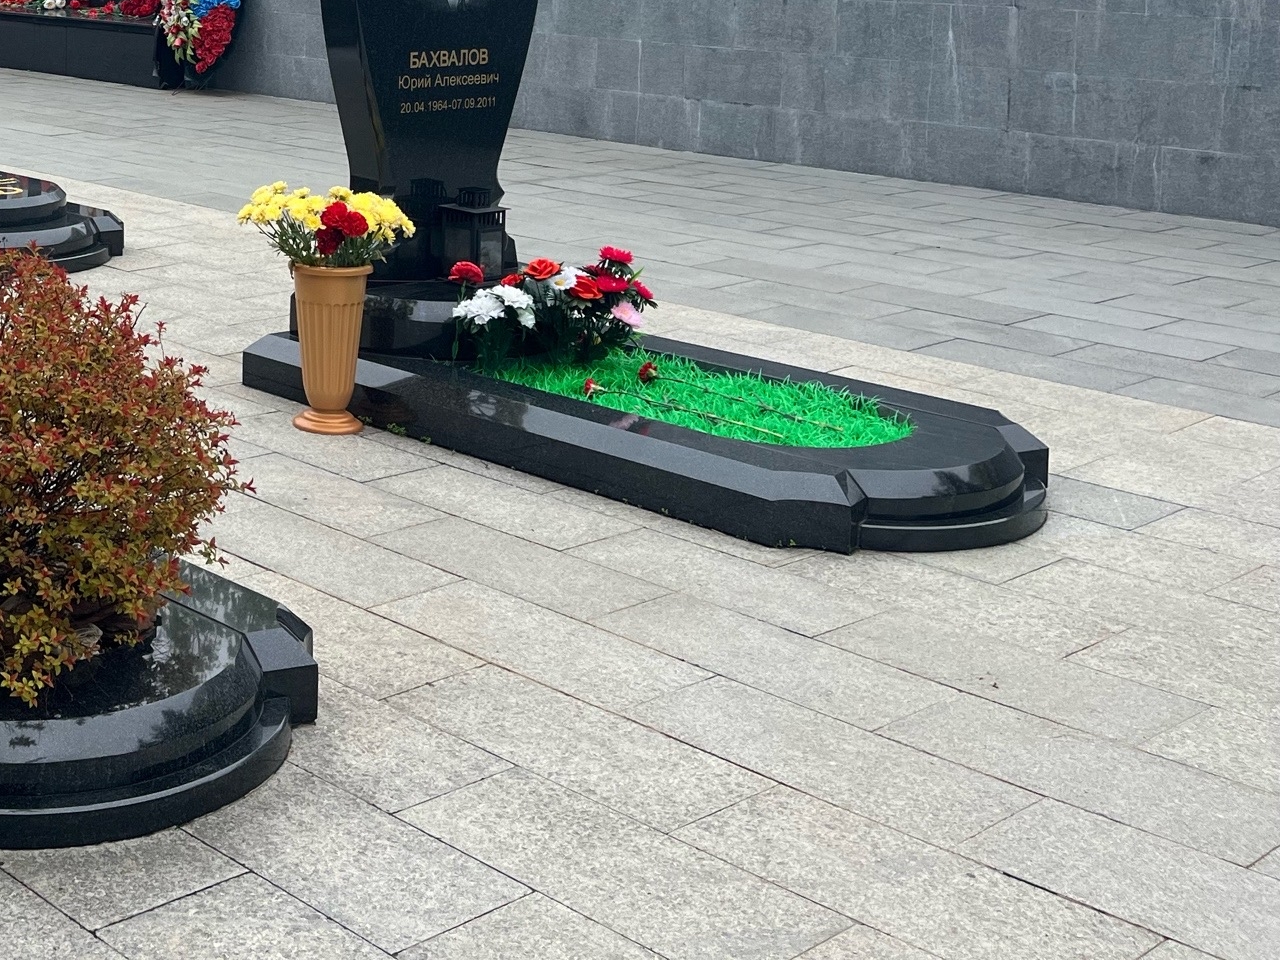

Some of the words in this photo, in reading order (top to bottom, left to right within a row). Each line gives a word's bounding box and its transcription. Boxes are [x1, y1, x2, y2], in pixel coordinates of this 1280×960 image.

[410, 48, 489, 69] БАХВАЛОВ
[398, 74, 432, 91] Юрий
[434, 72, 500, 88] Алексеевич
[400, 96, 496, 114] 20.04.1964-07.09.2011
